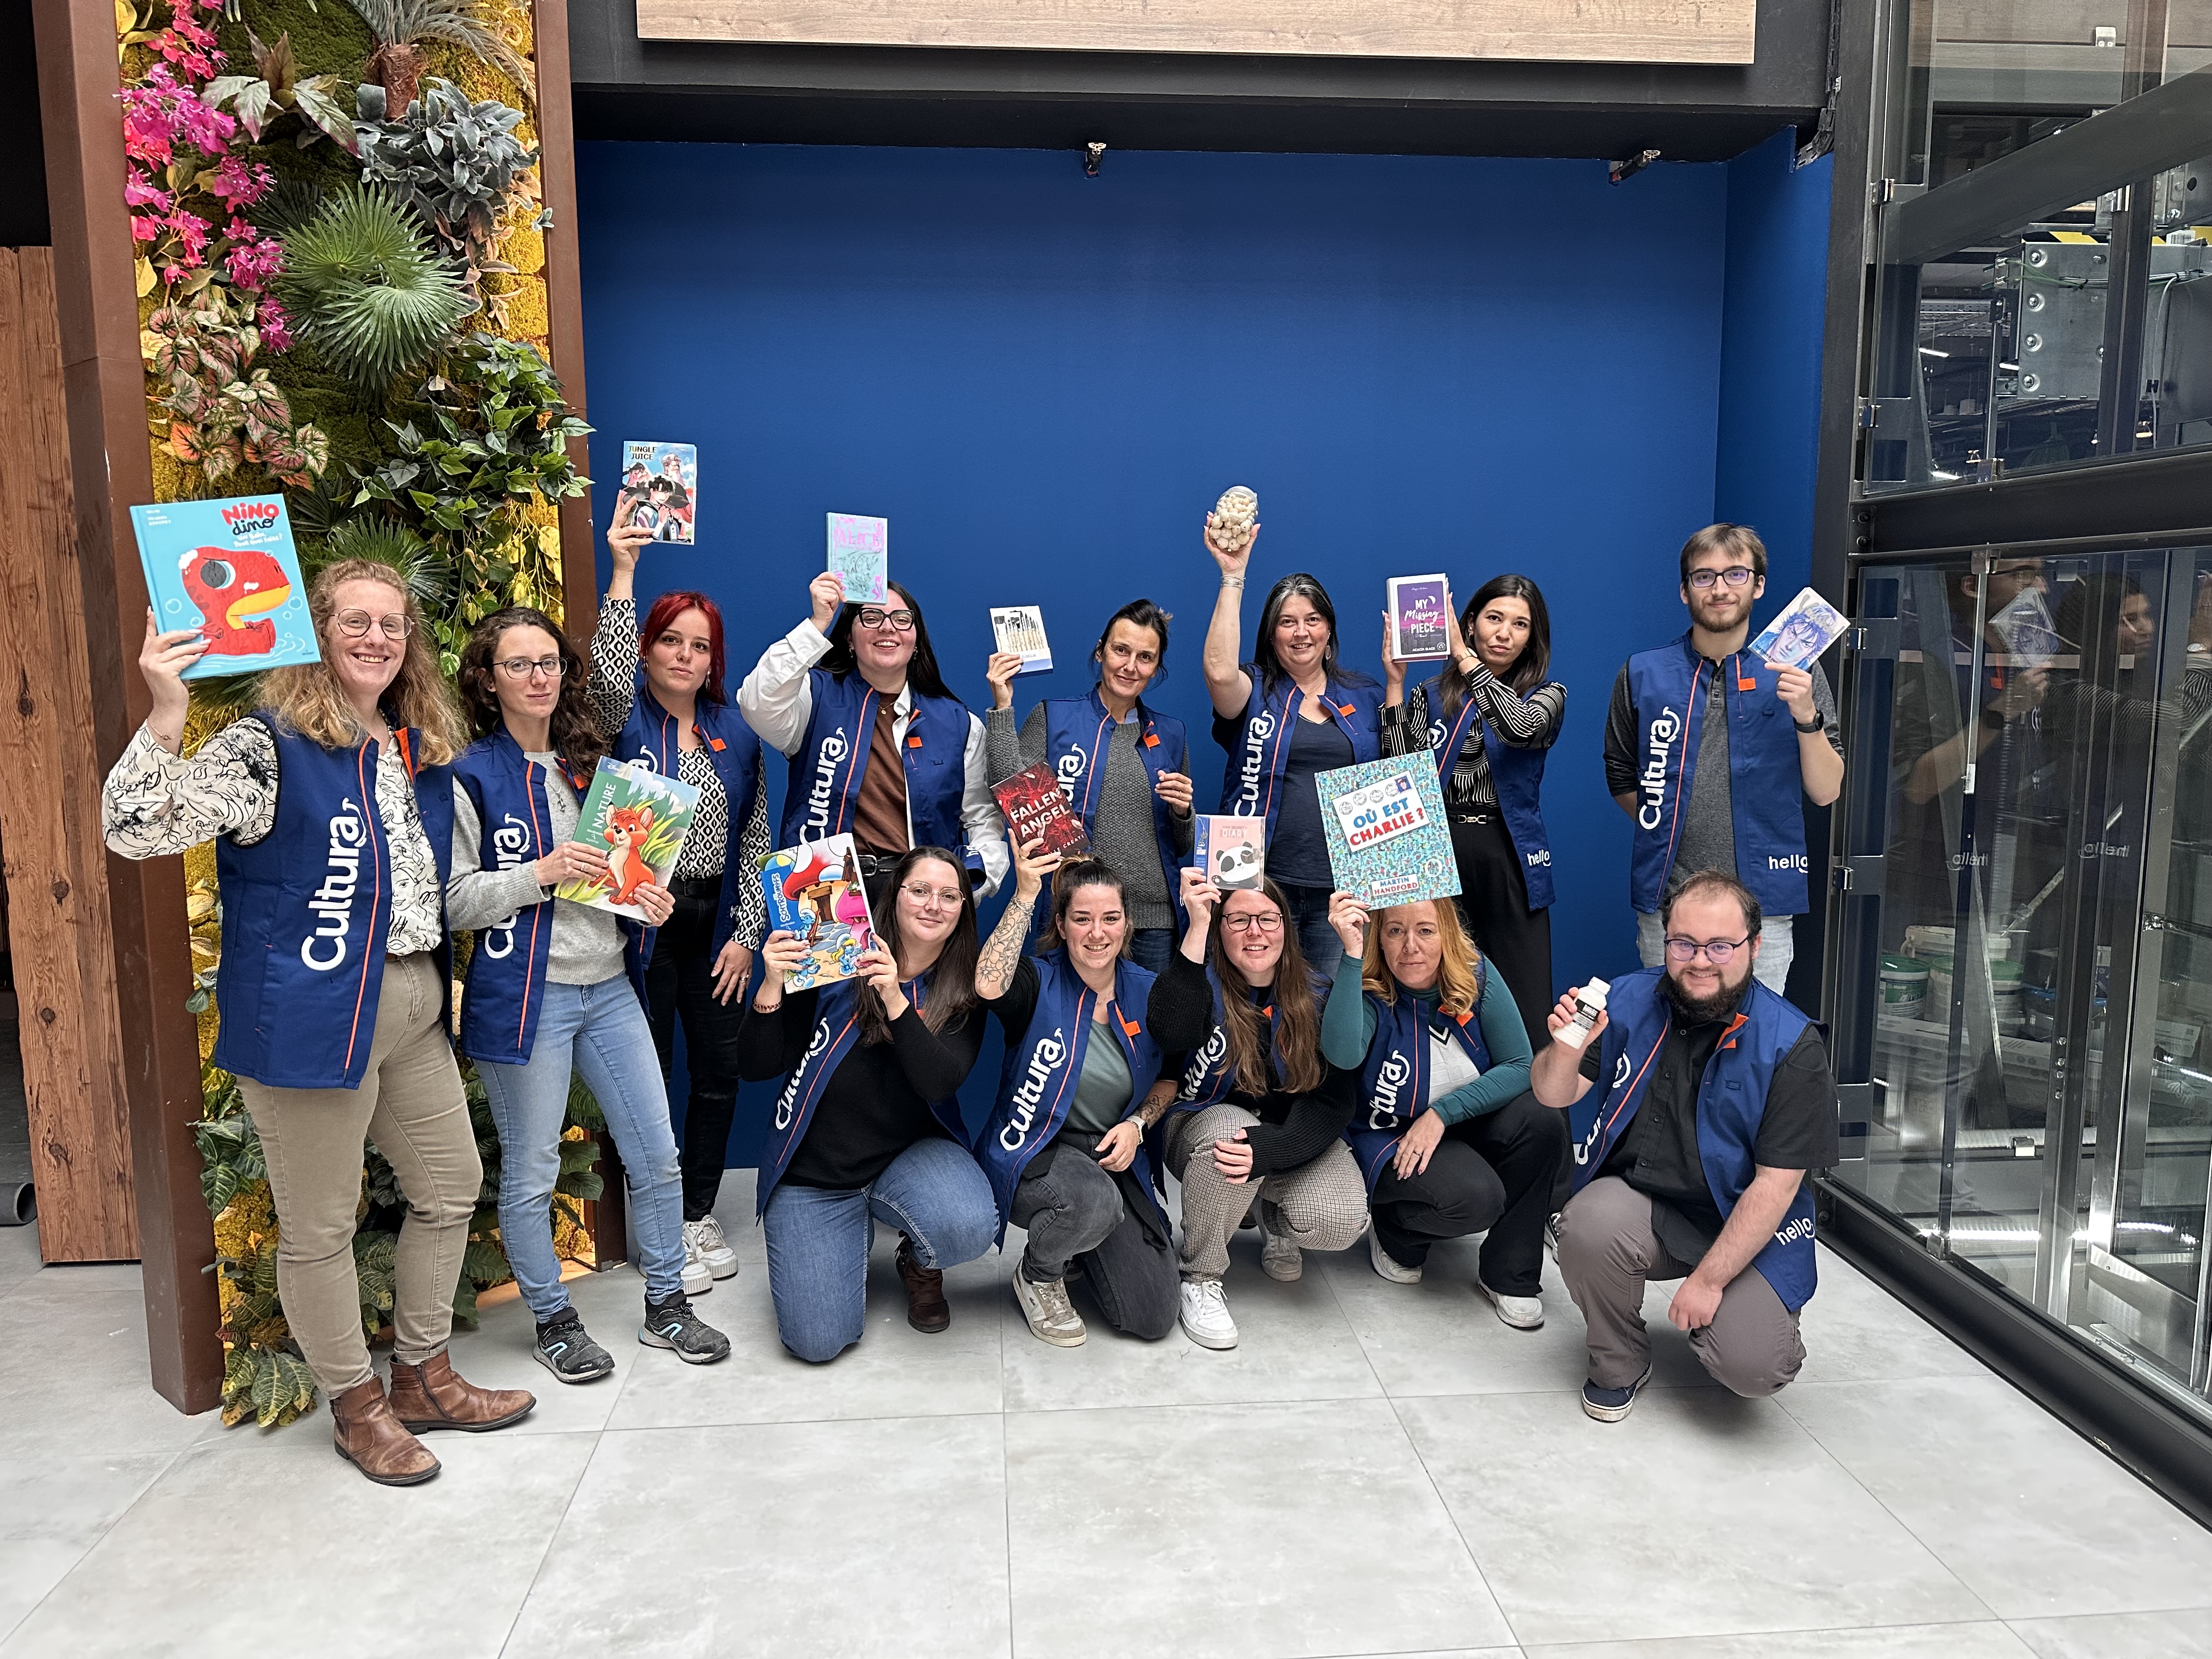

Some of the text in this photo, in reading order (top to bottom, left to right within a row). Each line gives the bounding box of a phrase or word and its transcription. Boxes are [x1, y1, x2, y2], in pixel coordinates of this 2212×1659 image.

[233, 516, 275, 535] dino
[838, 527, 880, 546] ALICE
[1404, 610, 1440, 622] Missing
[1415, 599, 1428, 610] MY
[1410, 623, 1435, 634] PIECE
[1234, 713, 1273, 816] Cultura
[1639, 713, 1678, 830] Cultura
[799, 732, 847, 845] Cultura
[592, 782, 617, 828] NATURE
[1010, 788, 1063, 824] FALLEN
[1020, 804, 1070, 838] ANGEL
[1353, 809, 1378, 828] OÙ
[1382, 797, 1408, 817] EST
[1222, 829, 1247, 838] DIARY
[1350, 808, 1424, 846] CHARLIE ?
[1527, 849, 1550, 866] hello
[1769, 854, 1808, 870] hello
[301, 805, 365, 970] Cultura
[485, 820, 528, 959] Cura
[771, 873, 790, 922] SCHTROUMPFS
[1374, 882, 1418, 895] HANDFORD
[1380, 877, 1409, 887] MARTIN
[1000, 1033, 1064, 1151] Cultura
[1369, 1056, 1407, 1130] Ctura
[1774, 1218, 1813, 1245] hello
